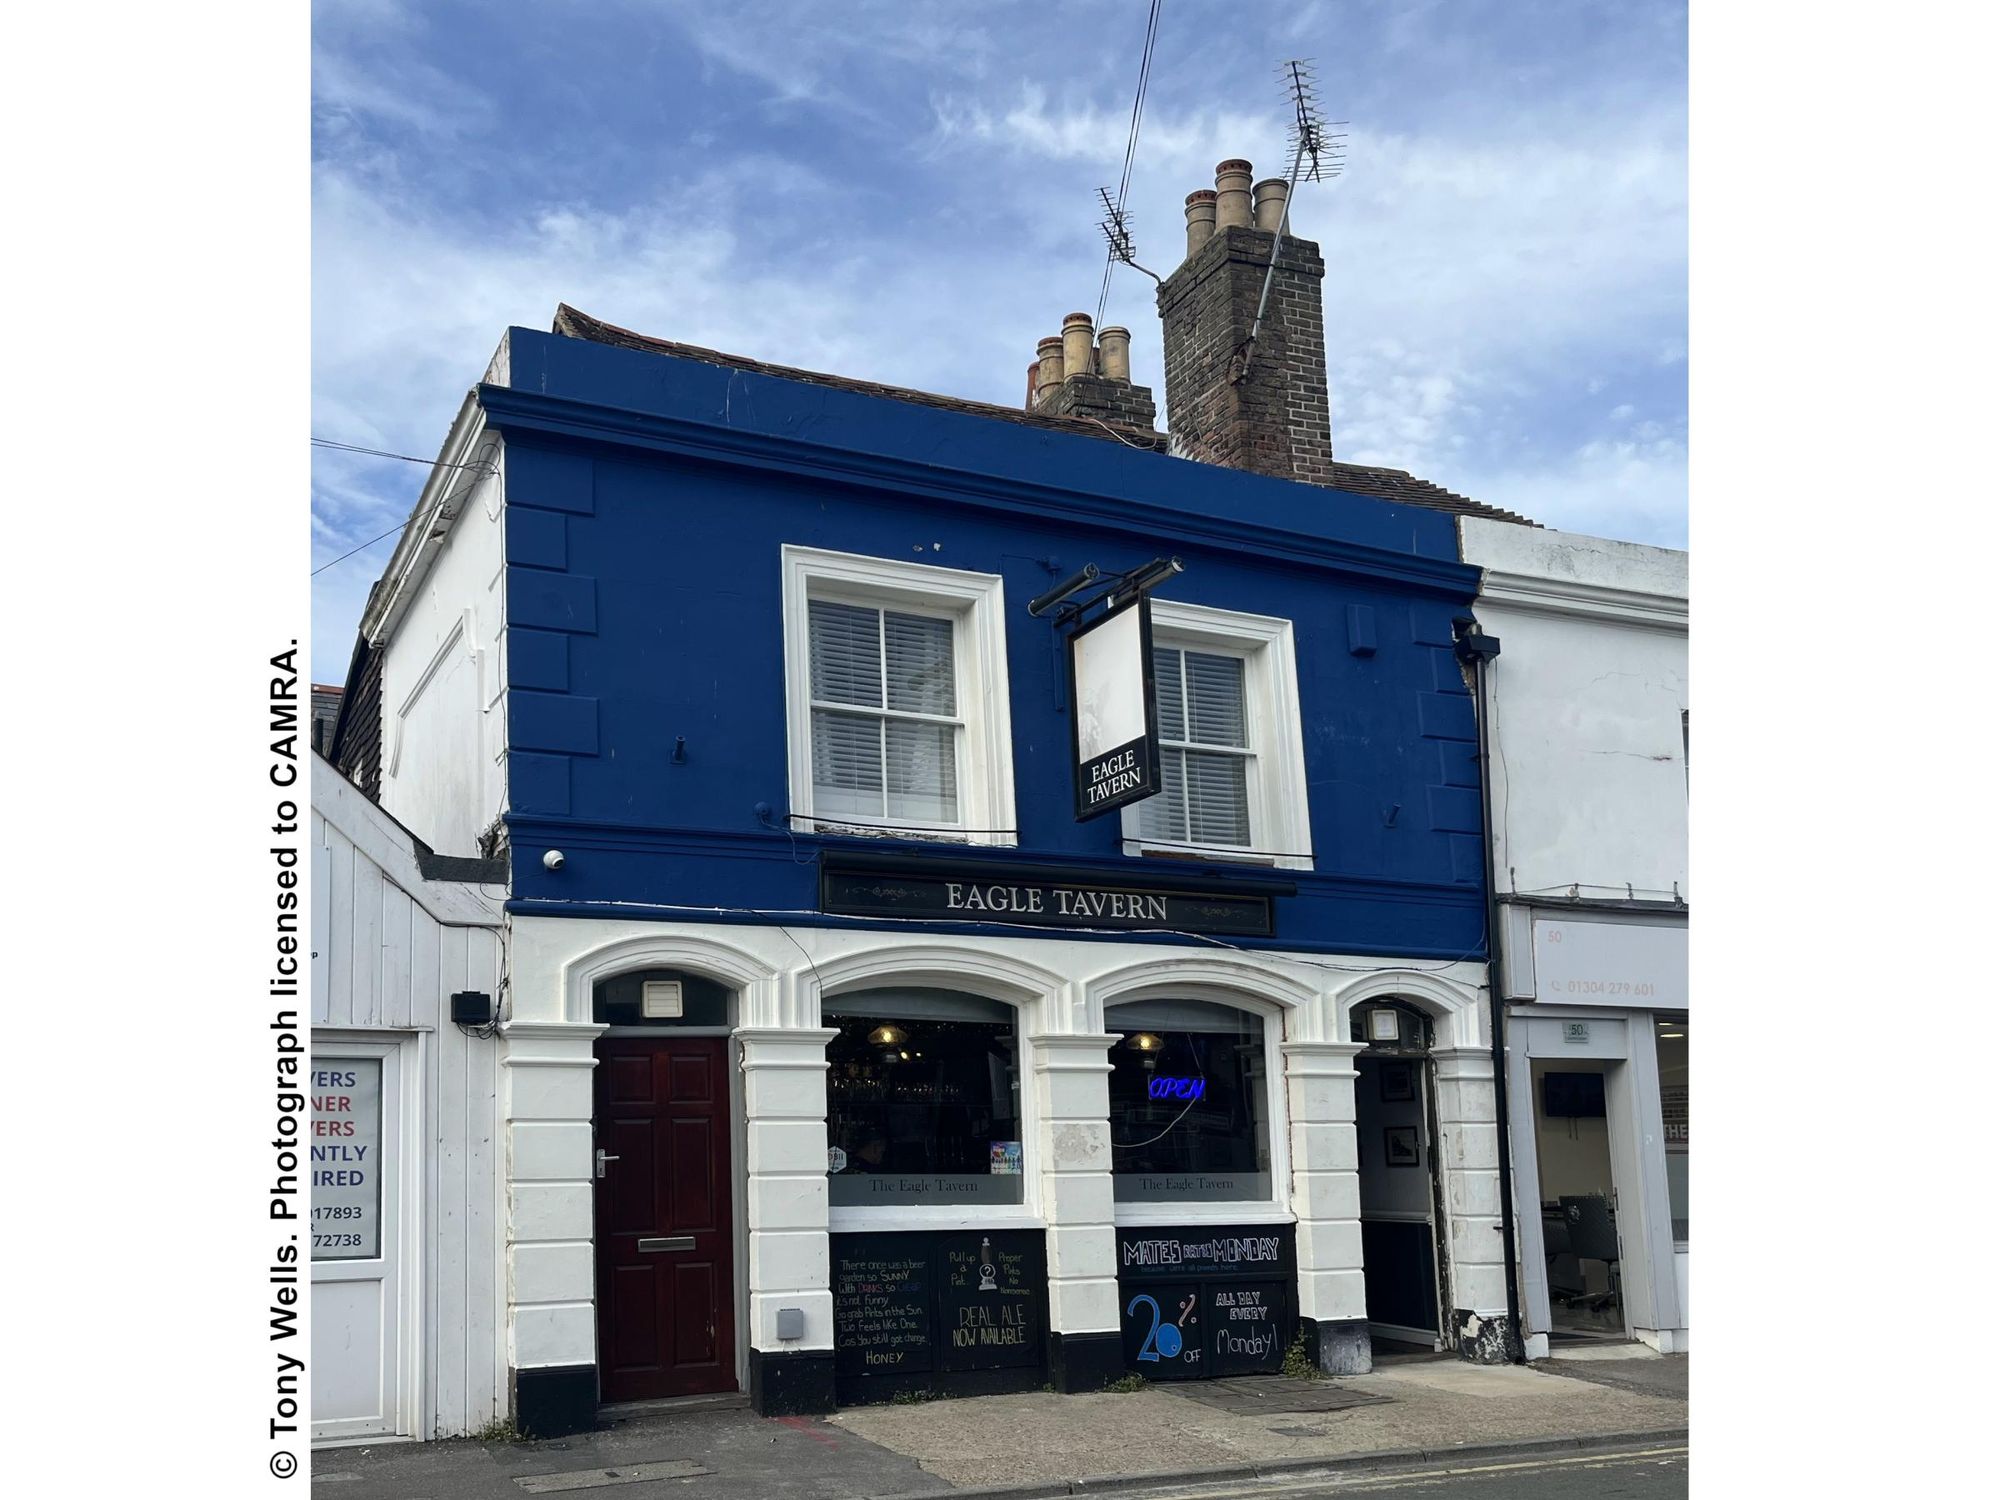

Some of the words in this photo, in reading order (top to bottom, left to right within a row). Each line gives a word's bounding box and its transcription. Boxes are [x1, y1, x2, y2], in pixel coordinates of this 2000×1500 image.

[1091, 749, 1135, 783] EAGLE
[1087, 766, 1141, 804] TAVERN
[945, 883, 1044, 913] EAGLE
[1052, 890, 1167, 920] TAVERN
[1548, 930, 1562, 943] 50
[1568, 980, 1605, 993] 01304
[1609, 982, 1631, 994] 279
[1634, 984, 1655, 996] 601
[1571, 1024, 1583, 1035] 50
[1150, 1077, 1205, 1098] OPEN
[311, 1121, 355, 1137] ERS
[314, 1170, 364, 1186] IRED
[869, 1179, 895, 1192] The
[899, 1179, 931, 1193] Eagle
[935, 1178, 978, 1192] Tavern
[1139, 1178, 1162, 1190] The
[1166, 1178, 1193, 1191] Eagle
[1197, 1177, 1233, 1189] Tavern
[949, 1251, 965, 1264] Pull
[966, 1255, 976, 1264] up
[1123, 1240, 1182, 1266] MATES
[1213, 1237, 1279, 1263] MONDAY
[840, 1260, 866, 1271] There
[868, 1262, 887, 1271] once
[960, 1264, 967, 1272] a
[1215, 1292, 1236, 1306] ALL
[1237, 1291, 1261, 1305] DAY
[959, 1306, 997, 1328] REAL
[1001, 1304, 1027, 1326] ALE
[1229, 1306, 1268, 1320] EVERY
[952, 1328, 977, 1347] NOW
[866, 1350, 904, 1365] HONEY
[1184, 1349, 1202, 1363] OFF
